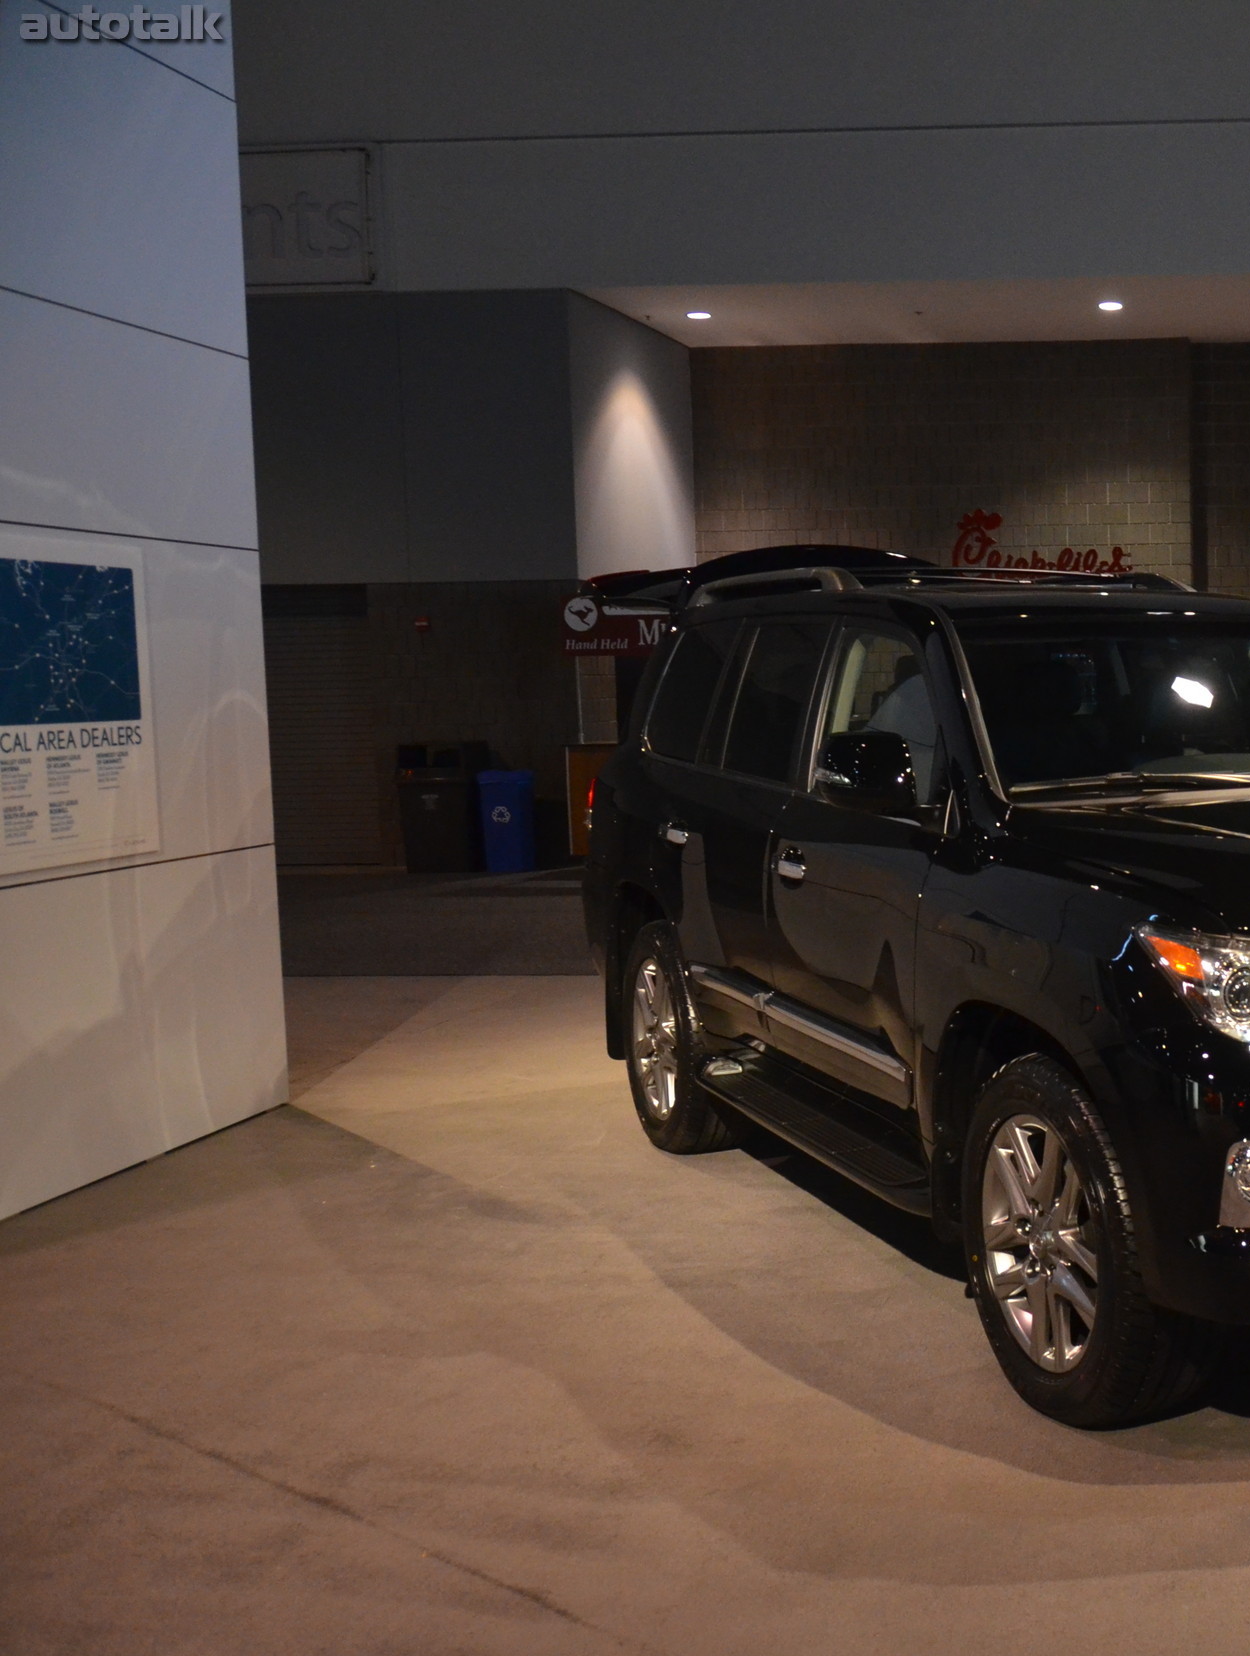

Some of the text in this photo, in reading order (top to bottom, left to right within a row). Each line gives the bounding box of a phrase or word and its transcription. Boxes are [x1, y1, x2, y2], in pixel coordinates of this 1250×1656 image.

[565, 638, 629, 650] Hand Held
[36, 729, 77, 751] AREA
[80, 725, 143, 749] DEALERS
